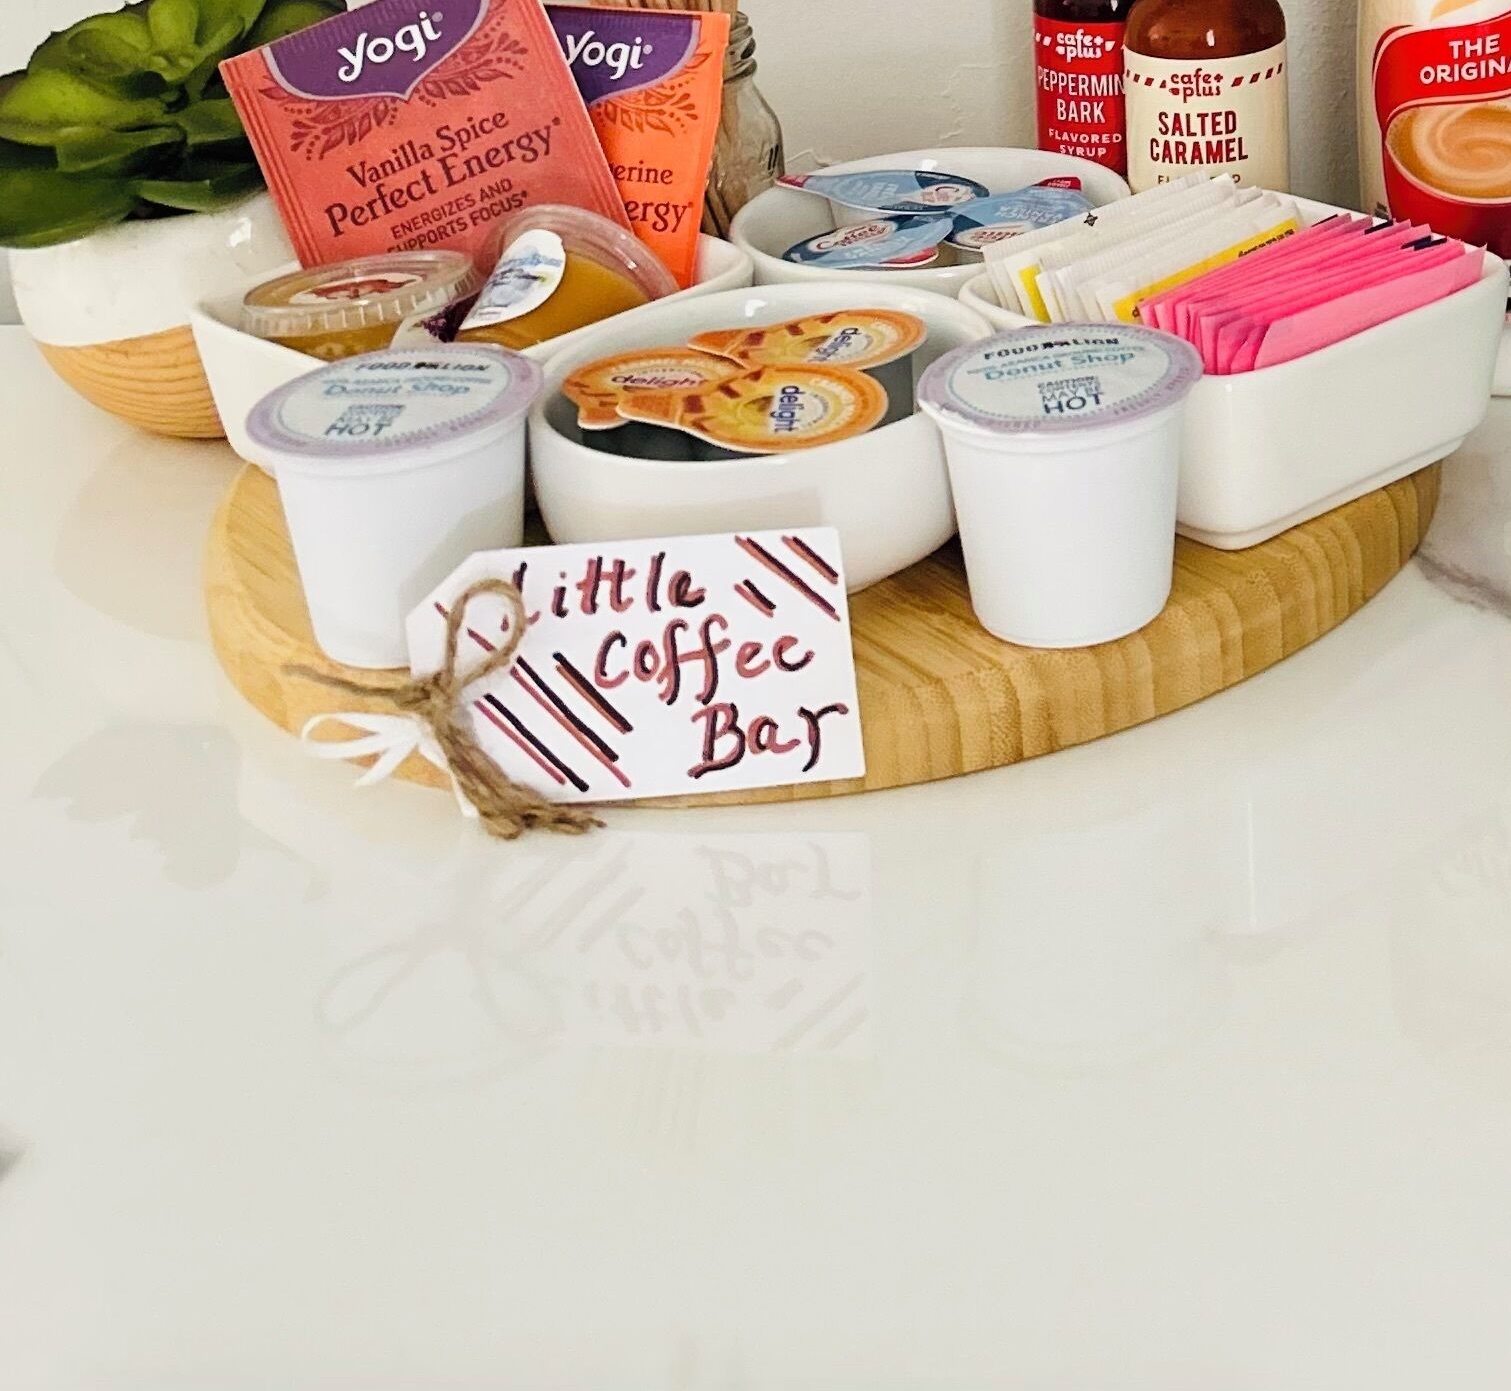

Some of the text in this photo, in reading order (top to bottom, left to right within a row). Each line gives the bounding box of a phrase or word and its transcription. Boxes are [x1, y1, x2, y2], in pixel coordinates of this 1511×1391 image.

[337, 11, 442, 82] yogi
[566, 30, 643, 80] yogi
[1066, 46, 1102, 62] plus
[1449, 33, 1500, 59] THE
[1038, 65, 1125, 97] PEPPERMIN
[1183, 85, 1221, 103] plus
[1056, 98, 1106, 124] BARK
[1158, 110, 1237, 137] SALTED
[346, 112, 509, 188] Vanilla Spice
[1048, 128, 1122, 144] FLAVORED
[1150, 136, 1249, 165] CARAMEL
[1059, 144, 1107, 158] SYRUP
[324, 124, 553, 237] Perfect Energy
[611, 160, 673, 185] erine
[390, 178, 513, 240] ENERGIZES AND
[625, 200, 688, 233] ergy
[982, 344, 1039, 360] FOOD
[984, 359, 1063, 381] Donut
[1070, 352, 1136, 365] Shop
[769, 385, 806, 434] delight
[1043, 392, 1102, 414] HOT
[324, 422, 394, 437] HOT
[594, 613, 815, 706] Coffee
[687, 701, 849, 779] Bar
